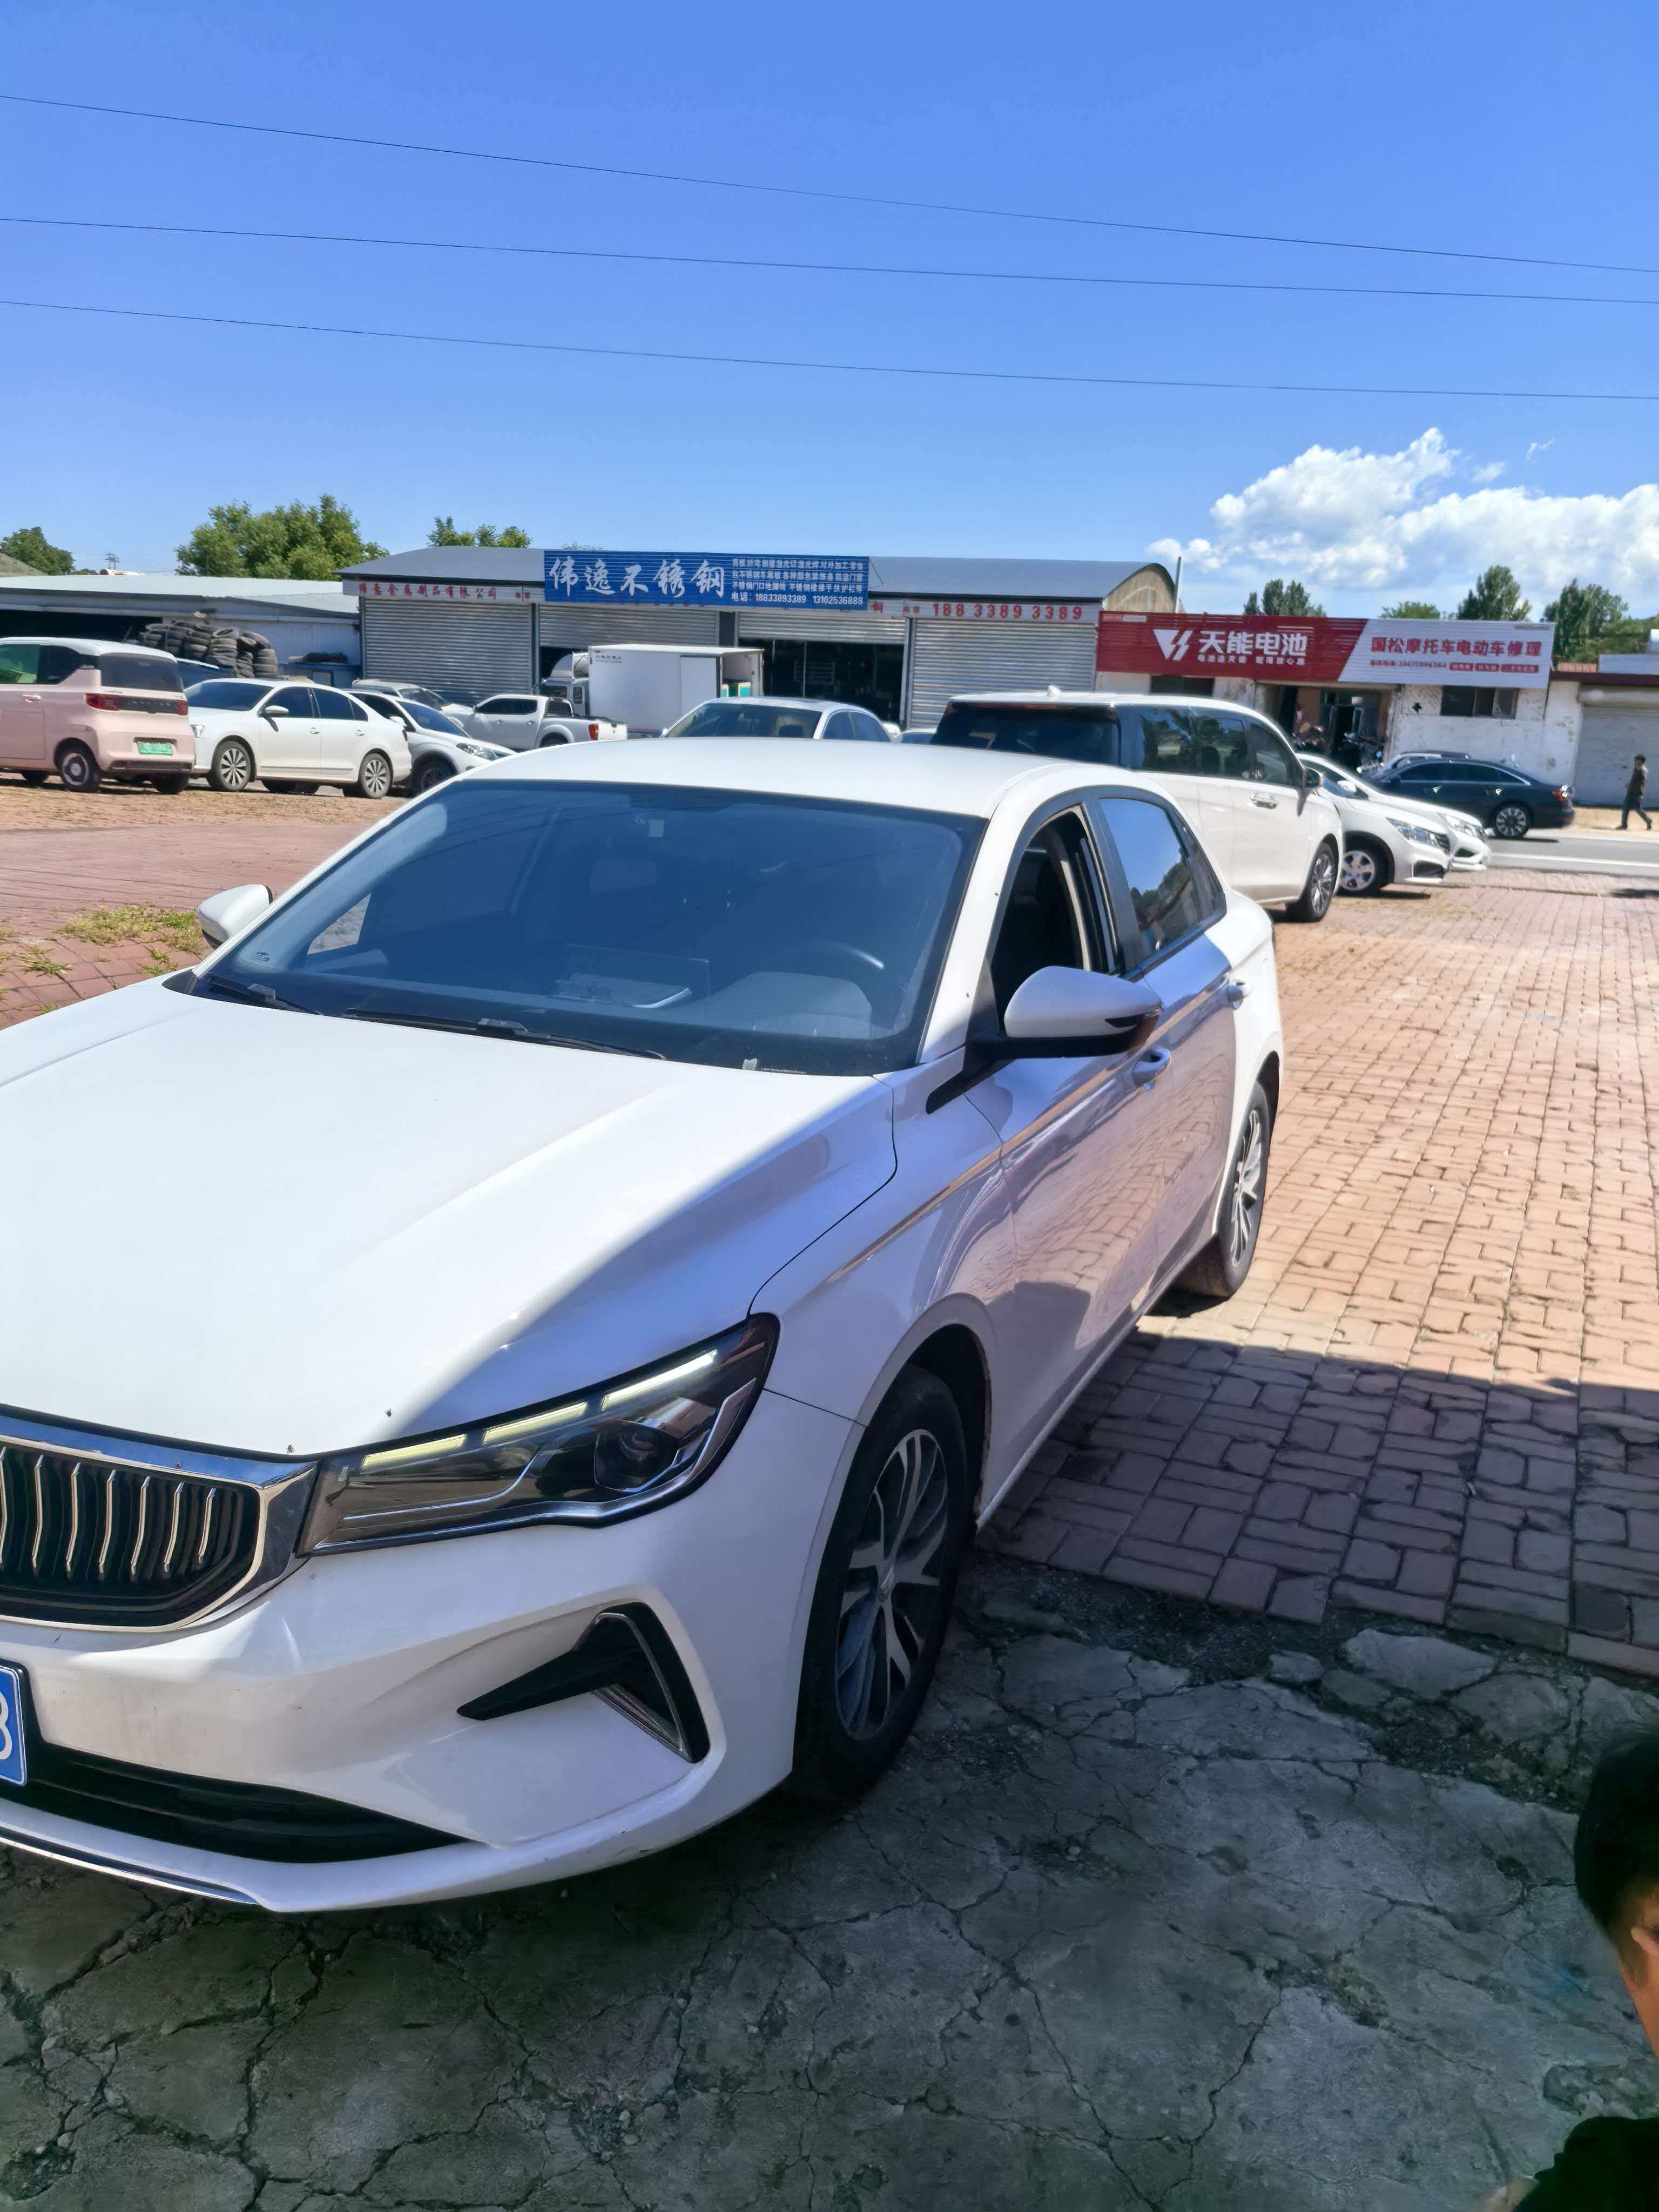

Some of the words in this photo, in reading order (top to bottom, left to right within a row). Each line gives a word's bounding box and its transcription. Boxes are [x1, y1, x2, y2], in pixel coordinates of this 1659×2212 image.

[549, 556, 725, 598] 伟逸不锈钢
[756, 593, 806, 604] 18833893389
[813, 595, 864, 605] 13102536888
[933, 602, 965, 617] 188
[974, 603, 1023, 619] 3389
[1032, 604, 1083, 621] 3389
[1199, 630, 1307, 657] 天能电池
